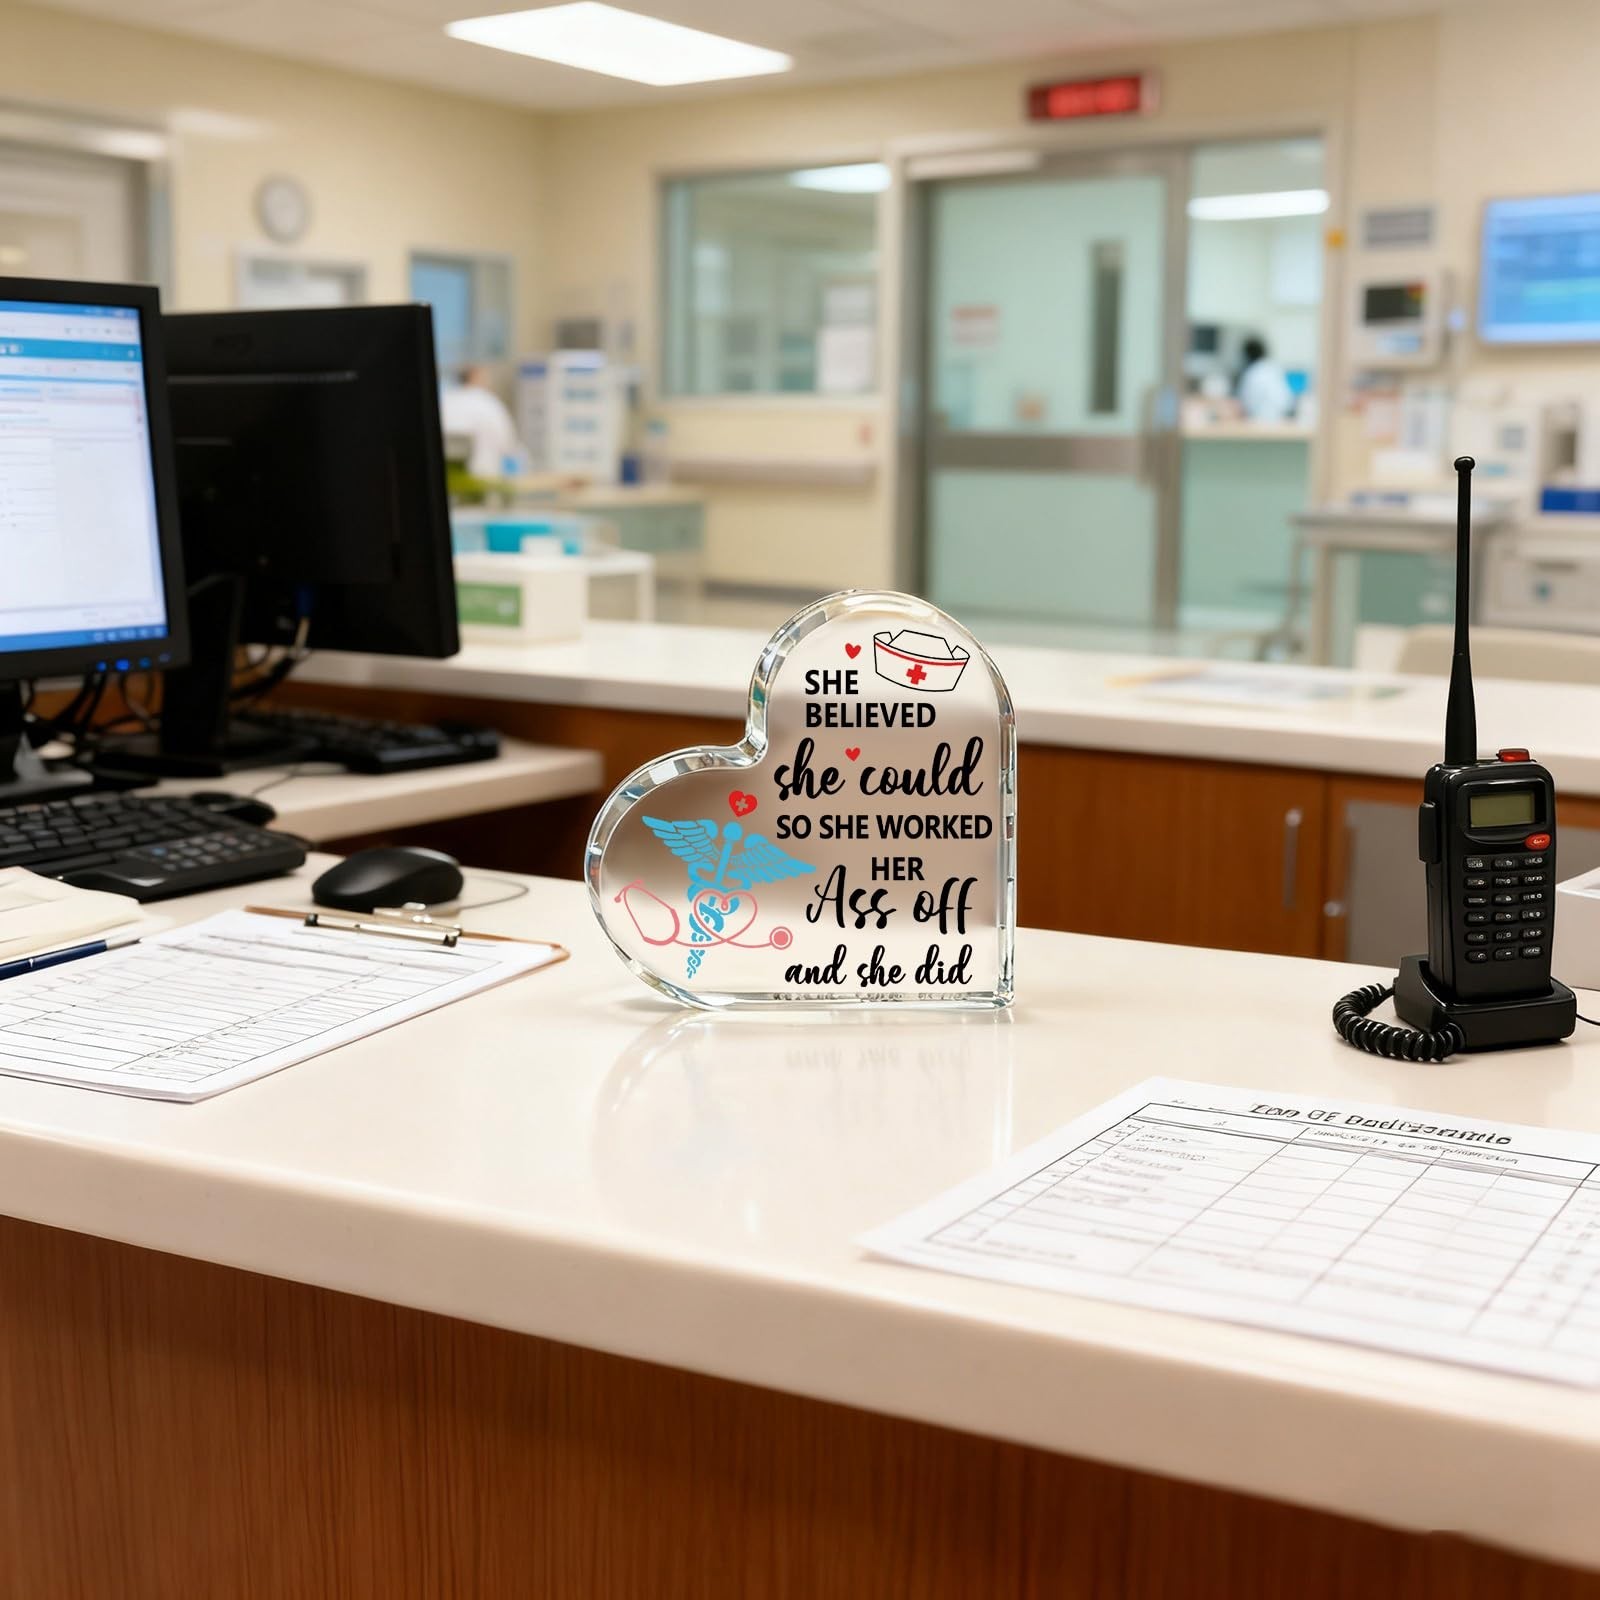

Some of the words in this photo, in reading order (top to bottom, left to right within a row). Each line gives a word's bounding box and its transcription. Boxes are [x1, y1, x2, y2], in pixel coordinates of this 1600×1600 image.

[805, 669, 859, 695] SHE
[805, 703, 936, 728] BELIEVED
[773, 737, 846, 801] she
[859, 736, 984, 797] could
[776, 815, 812, 839] SO
[819, 815, 869, 839] SHE
[876, 815, 993, 839] WORKED
[872, 857, 925, 881] HER
[806, 865, 896, 929] Ass
[912, 876, 978, 934] off
[784, 944, 847, 985] and
[856, 945, 906, 987] she
[914, 944, 973, 985] did
